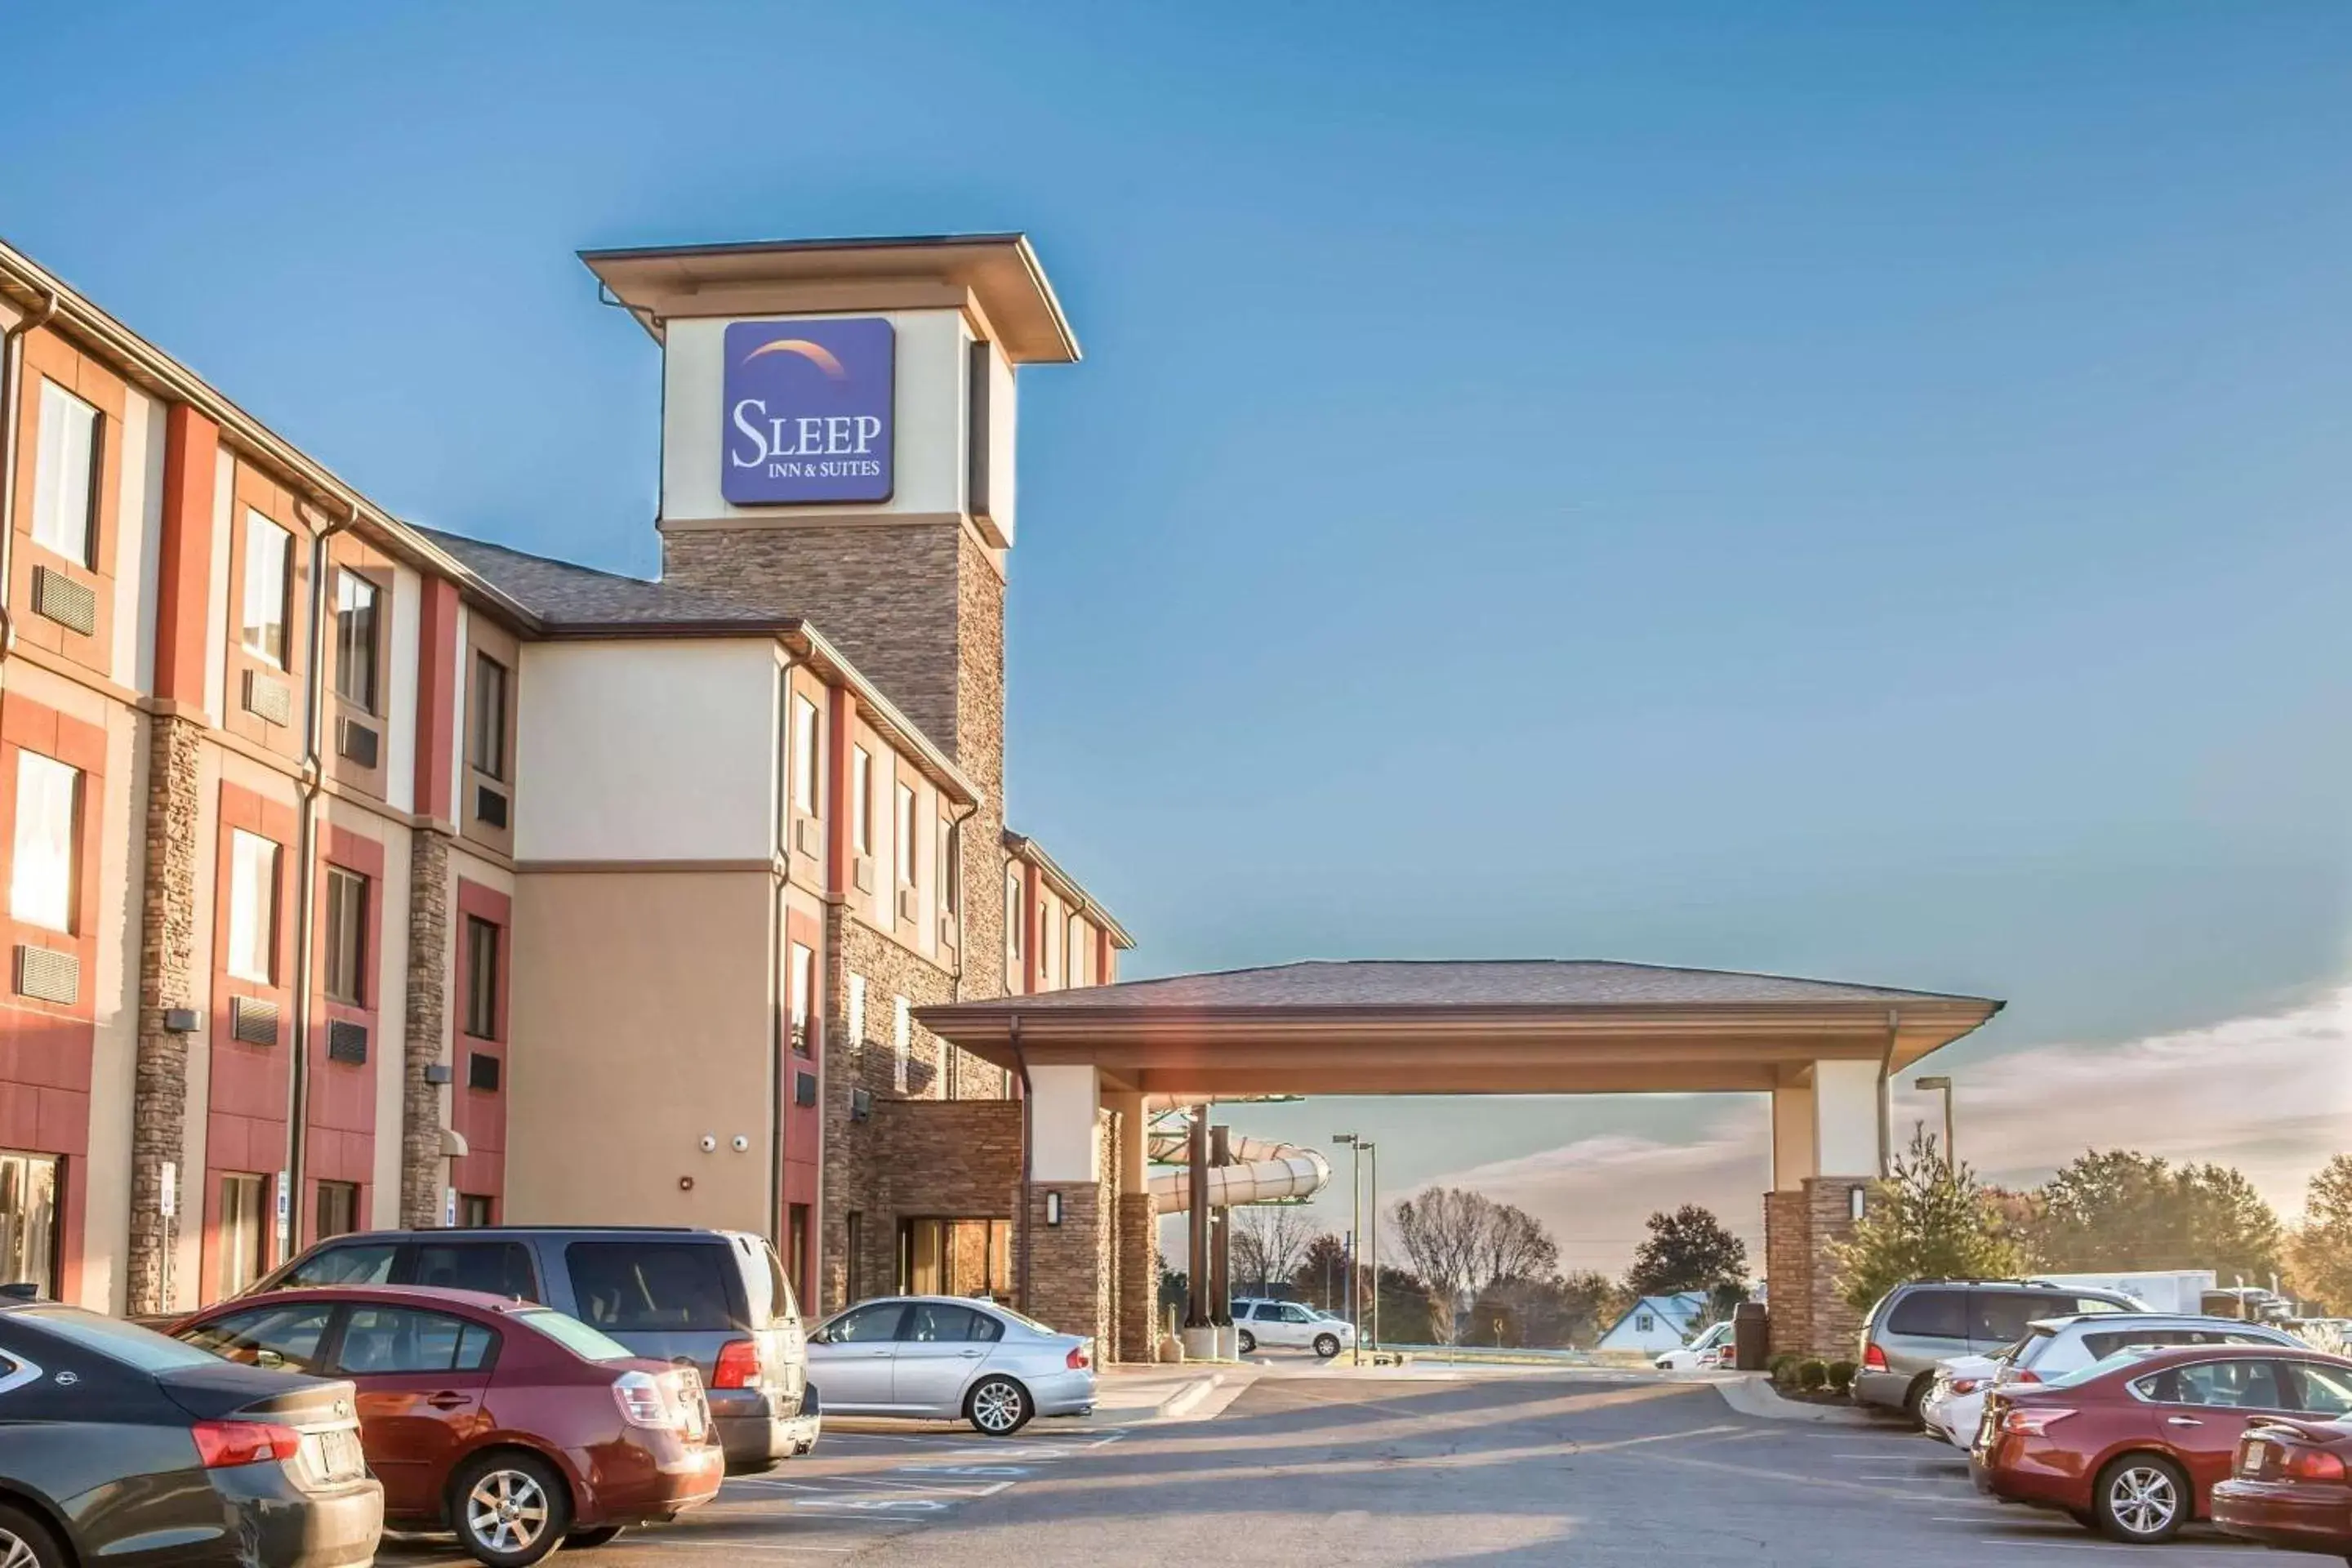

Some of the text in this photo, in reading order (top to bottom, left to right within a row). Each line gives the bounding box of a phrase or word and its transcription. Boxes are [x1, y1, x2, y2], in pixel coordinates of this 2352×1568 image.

[733, 399, 881, 468] SLEEP
[768, 461, 880, 478] INN & SUITES
